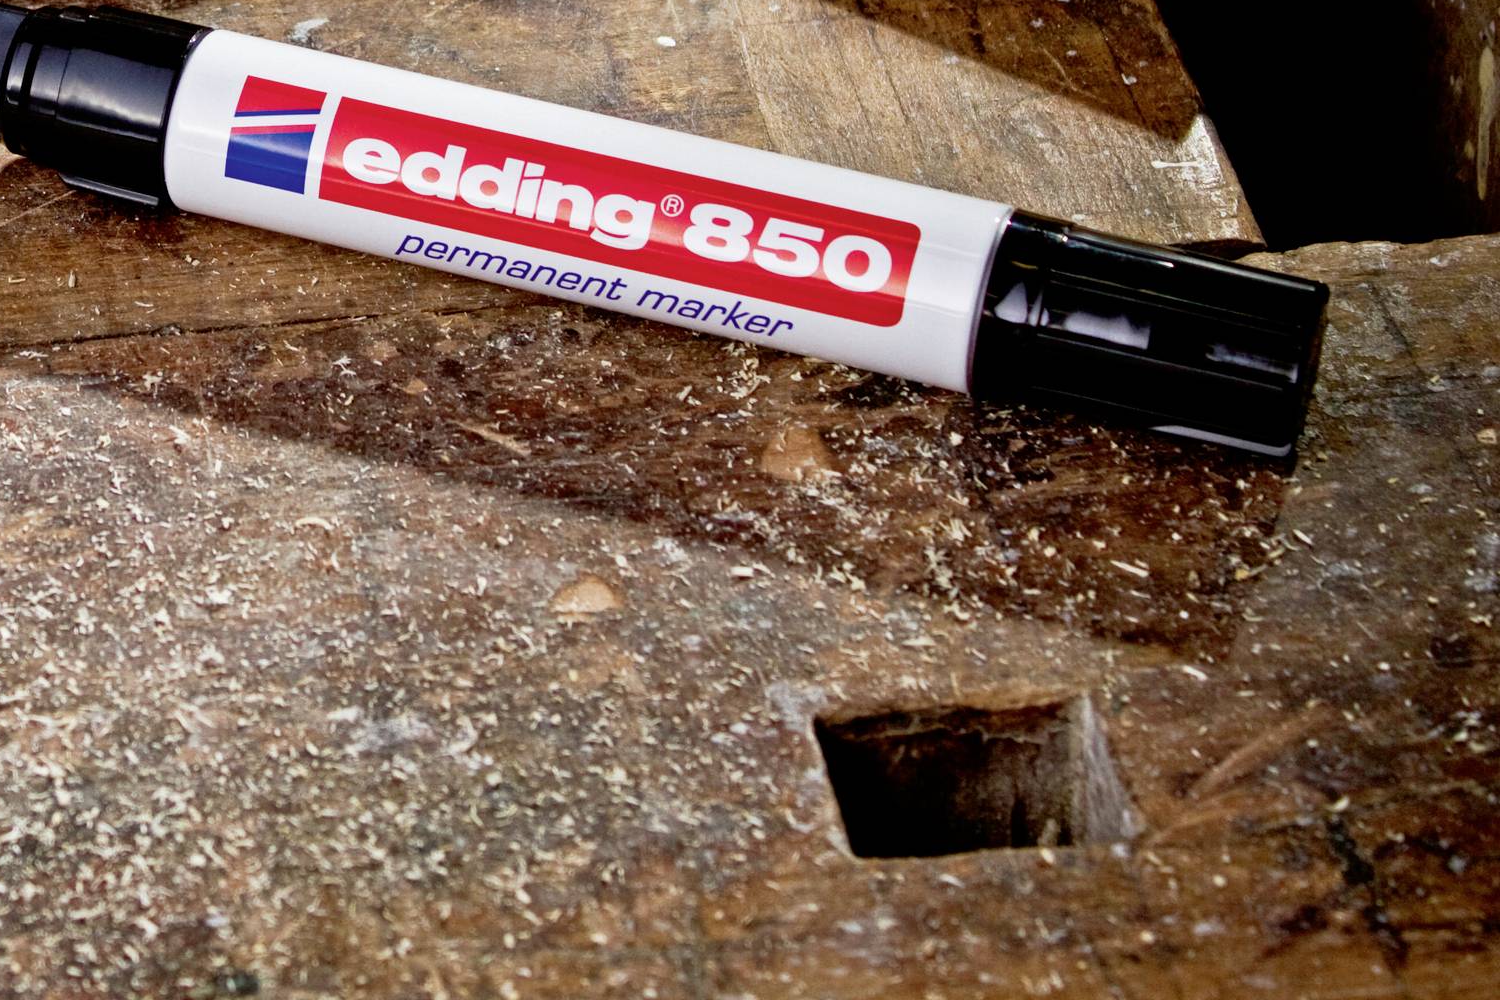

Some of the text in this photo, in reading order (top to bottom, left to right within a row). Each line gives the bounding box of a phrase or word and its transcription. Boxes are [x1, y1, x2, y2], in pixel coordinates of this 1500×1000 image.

[396, 231, 795, 338] permanent marker
[683, 203, 894, 294] 850
